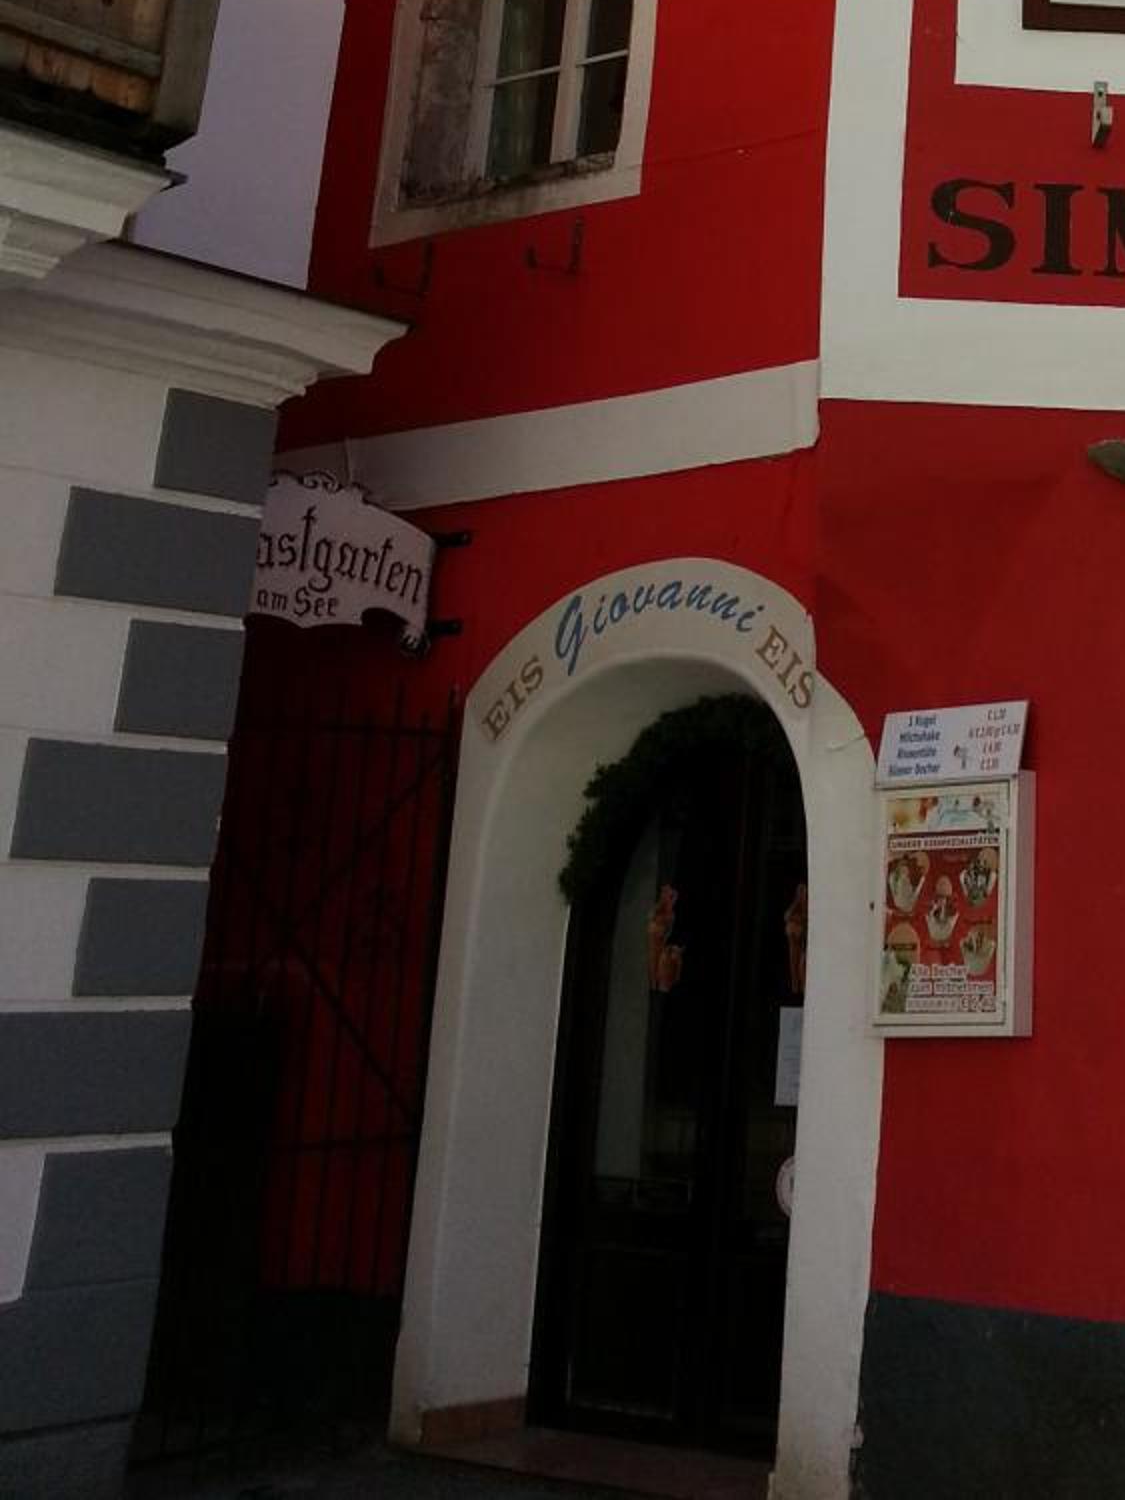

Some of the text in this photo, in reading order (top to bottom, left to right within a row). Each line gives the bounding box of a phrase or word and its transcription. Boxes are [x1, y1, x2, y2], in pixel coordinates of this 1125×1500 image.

[256, 505, 424, 605] astgarten
[257, 585, 338, 618] am See
[481, 579, 816, 742] EIS Giovanni EIS
